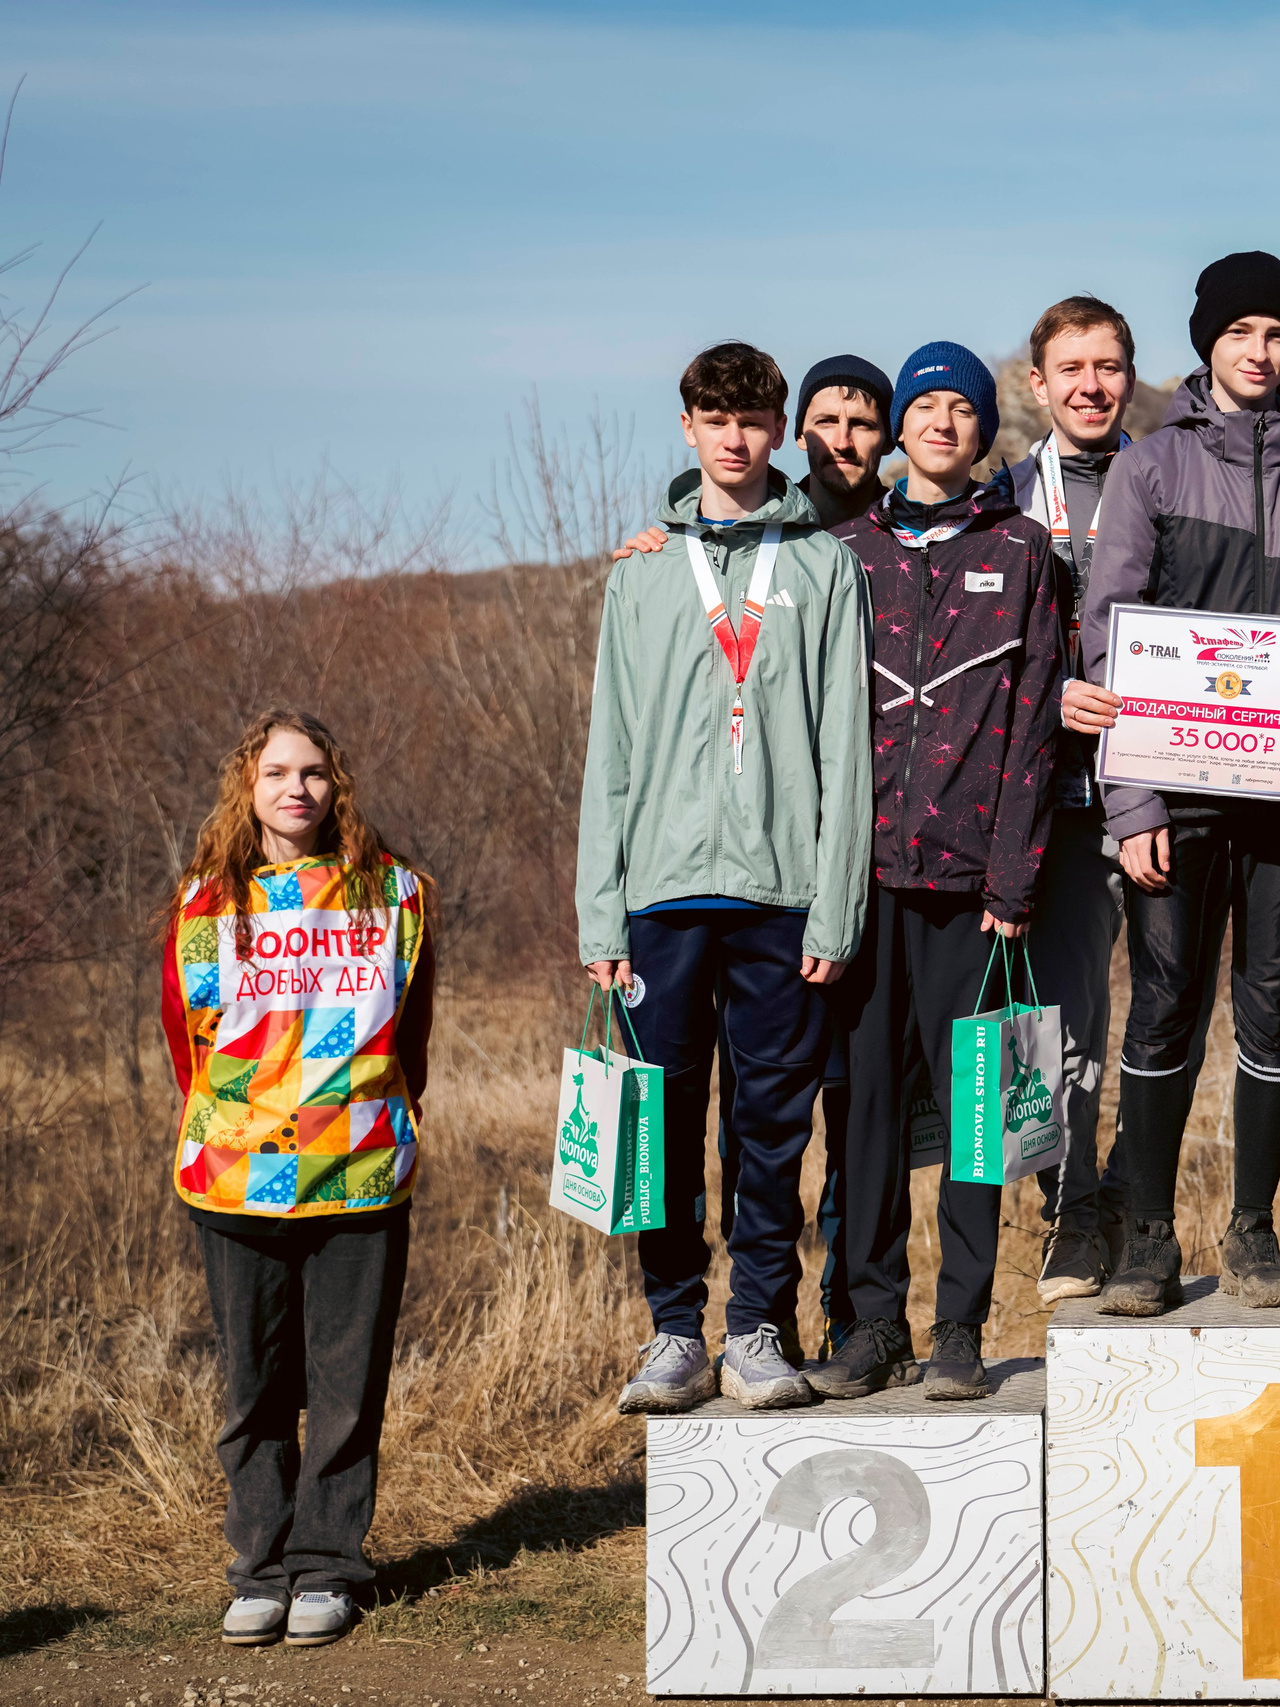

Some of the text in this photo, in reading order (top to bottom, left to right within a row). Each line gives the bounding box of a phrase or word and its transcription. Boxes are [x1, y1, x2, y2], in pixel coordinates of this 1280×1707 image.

[1130, 640, 1181, 659] O-TRAIL
[1189, 629, 1244, 647] Эстафета
[1216, 652, 1254, 662] ПОКОЛЕНИЙ
[1126, 700, 1226, 720] ПОДАРОЧНЫЙ
[1169, 726, 1199, 747] 35
[236, 966, 387, 1002] ДОБЫХ ДЕЛ
[973, 1025, 986, 1178] BIONOVA-SHOP.RU
[1005, 1095, 1053, 1124] bionova
[560, 1130, 598, 1169] bionova
[1023, 1129, 1059, 1153] ДНЯ ОСНОВА
[623, 1116, 634, 1228] ПОДПИШИСЬ
[635, 1116, 652, 1225] PUBLIC_BIONOVA
[565, 1178, 601, 1204] ДНЯ ОСНОВА
[754, 1449, 934, 1669] 2
